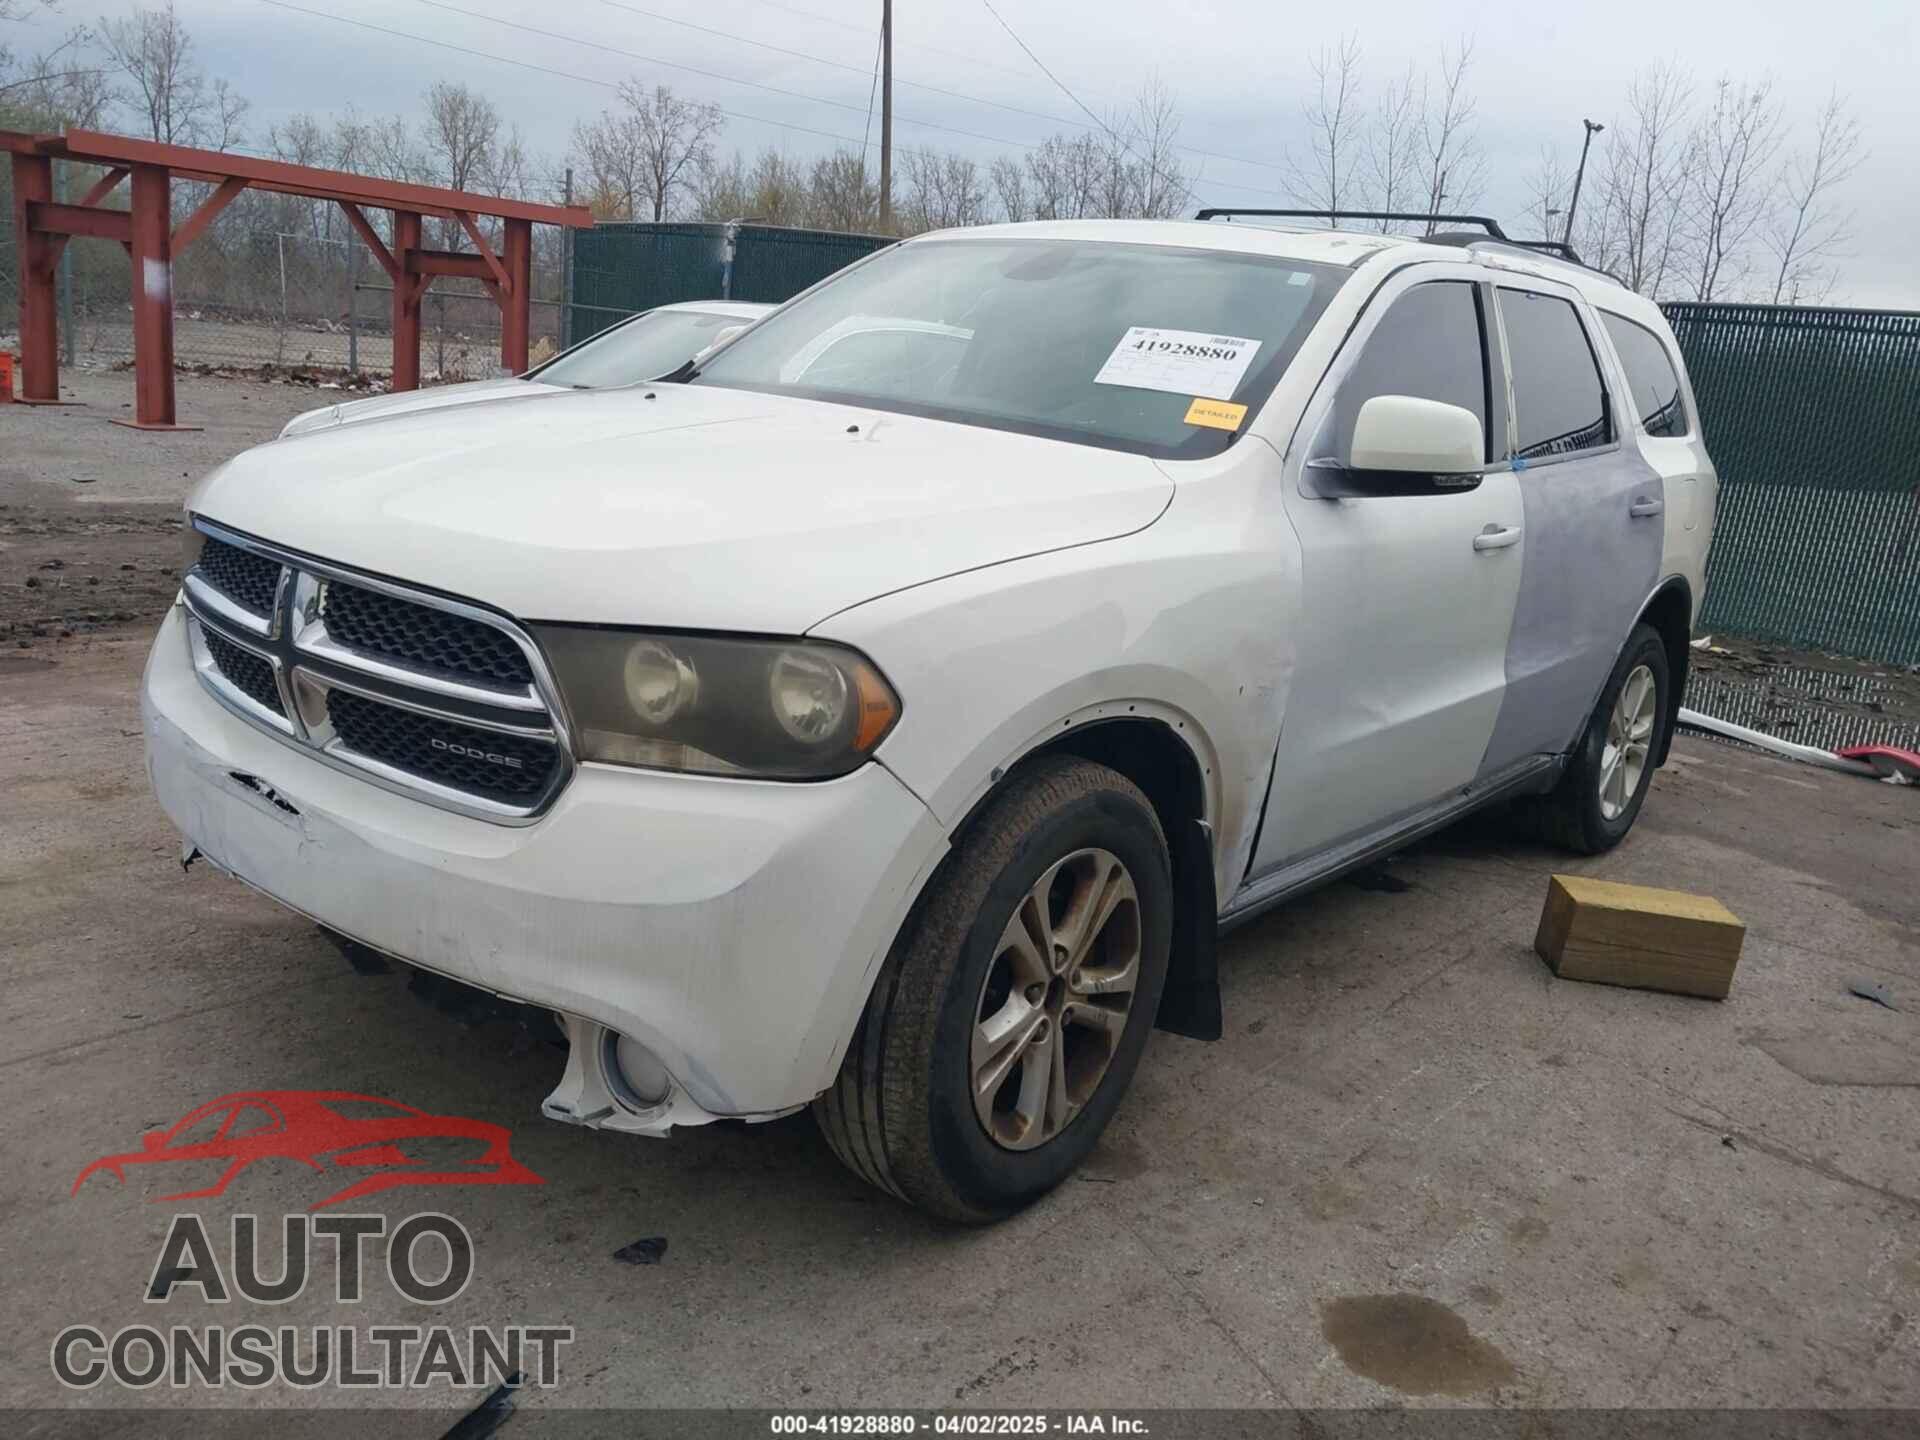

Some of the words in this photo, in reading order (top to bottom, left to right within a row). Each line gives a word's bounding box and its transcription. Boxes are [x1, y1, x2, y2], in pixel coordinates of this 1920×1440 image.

[1132, 339, 1237, 361] 41928880
[1193, 408, 1238, 420] DETAILED
[431, 738, 522, 769] DODGE
